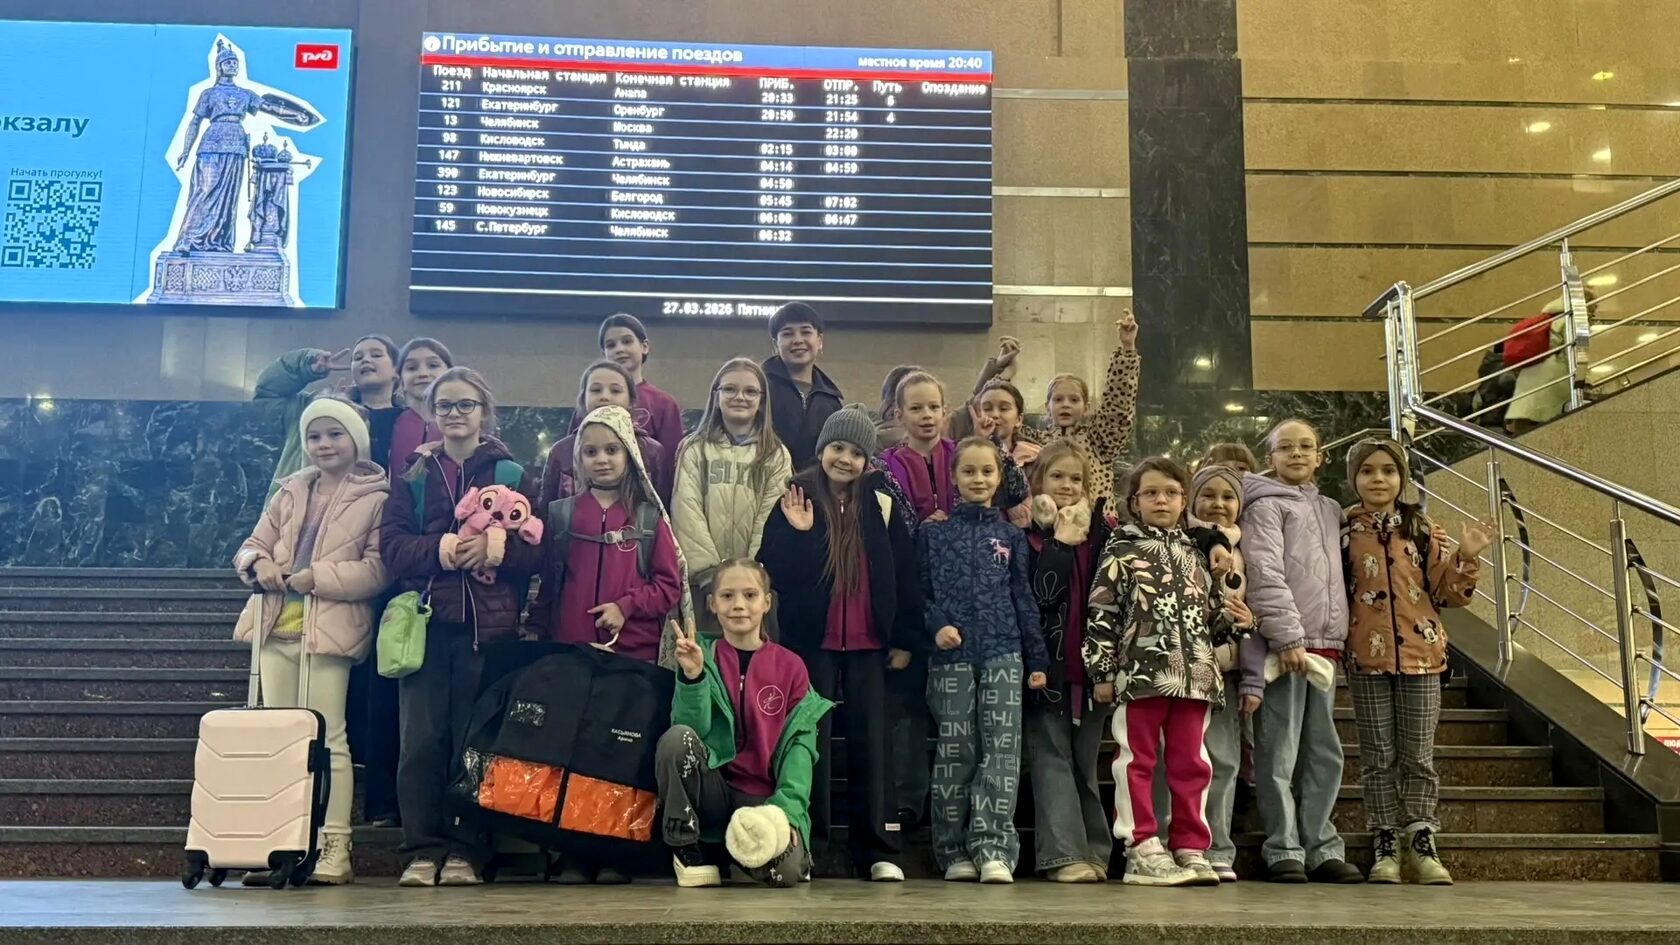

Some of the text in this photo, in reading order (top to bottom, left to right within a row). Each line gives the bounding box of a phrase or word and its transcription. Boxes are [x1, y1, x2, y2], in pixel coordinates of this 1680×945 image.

[442, 36, 743, 64] Прибытие и отправление поездов
[858, 57, 983, 70] местное время 20:40
[433, 65, 471, 79] Поезд
[483, 67, 606, 84] Начальная станция
[615, 72, 730, 90] Конечная станция
[759, 78, 794, 90] ПРИБ.
[824, 80, 859, 91] ОТПР.
[873, 81, 902, 94] Путь
[482, 81, 547, 96] Красноярск
[614, 87, 648, 99] Анапа
[922, 82, 986, 96] Опоздание
[481, 99, 559, 114] Екатеринбург
[613, 103, 665, 118] Оренбург
[480, 116, 539, 129] Челябинск
[613, 122, 652, 133] Москва
[480, 134, 545, 147] Кисловодск
[612, 139, 646, 152] Тында
[478, 151, 564, 166] Нижневартовск
[612, 156, 670, 170] Астрахань
[11, 168, 102, 179] Начать прогулку!
[478, 168, 556, 184] Екатеринбург
[612, 174, 670, 186] Челябинск
[477, 186, 550, 200] Новосибирск
[611, 191, 664, 205] Белгород
[477, 204, 549, 218] Новокузнецк
[611, 209, 675, 222] Кисловодск
[476, 221, 548, 236] С.Петербург
[610, 226, 669, 238] Челябинск
